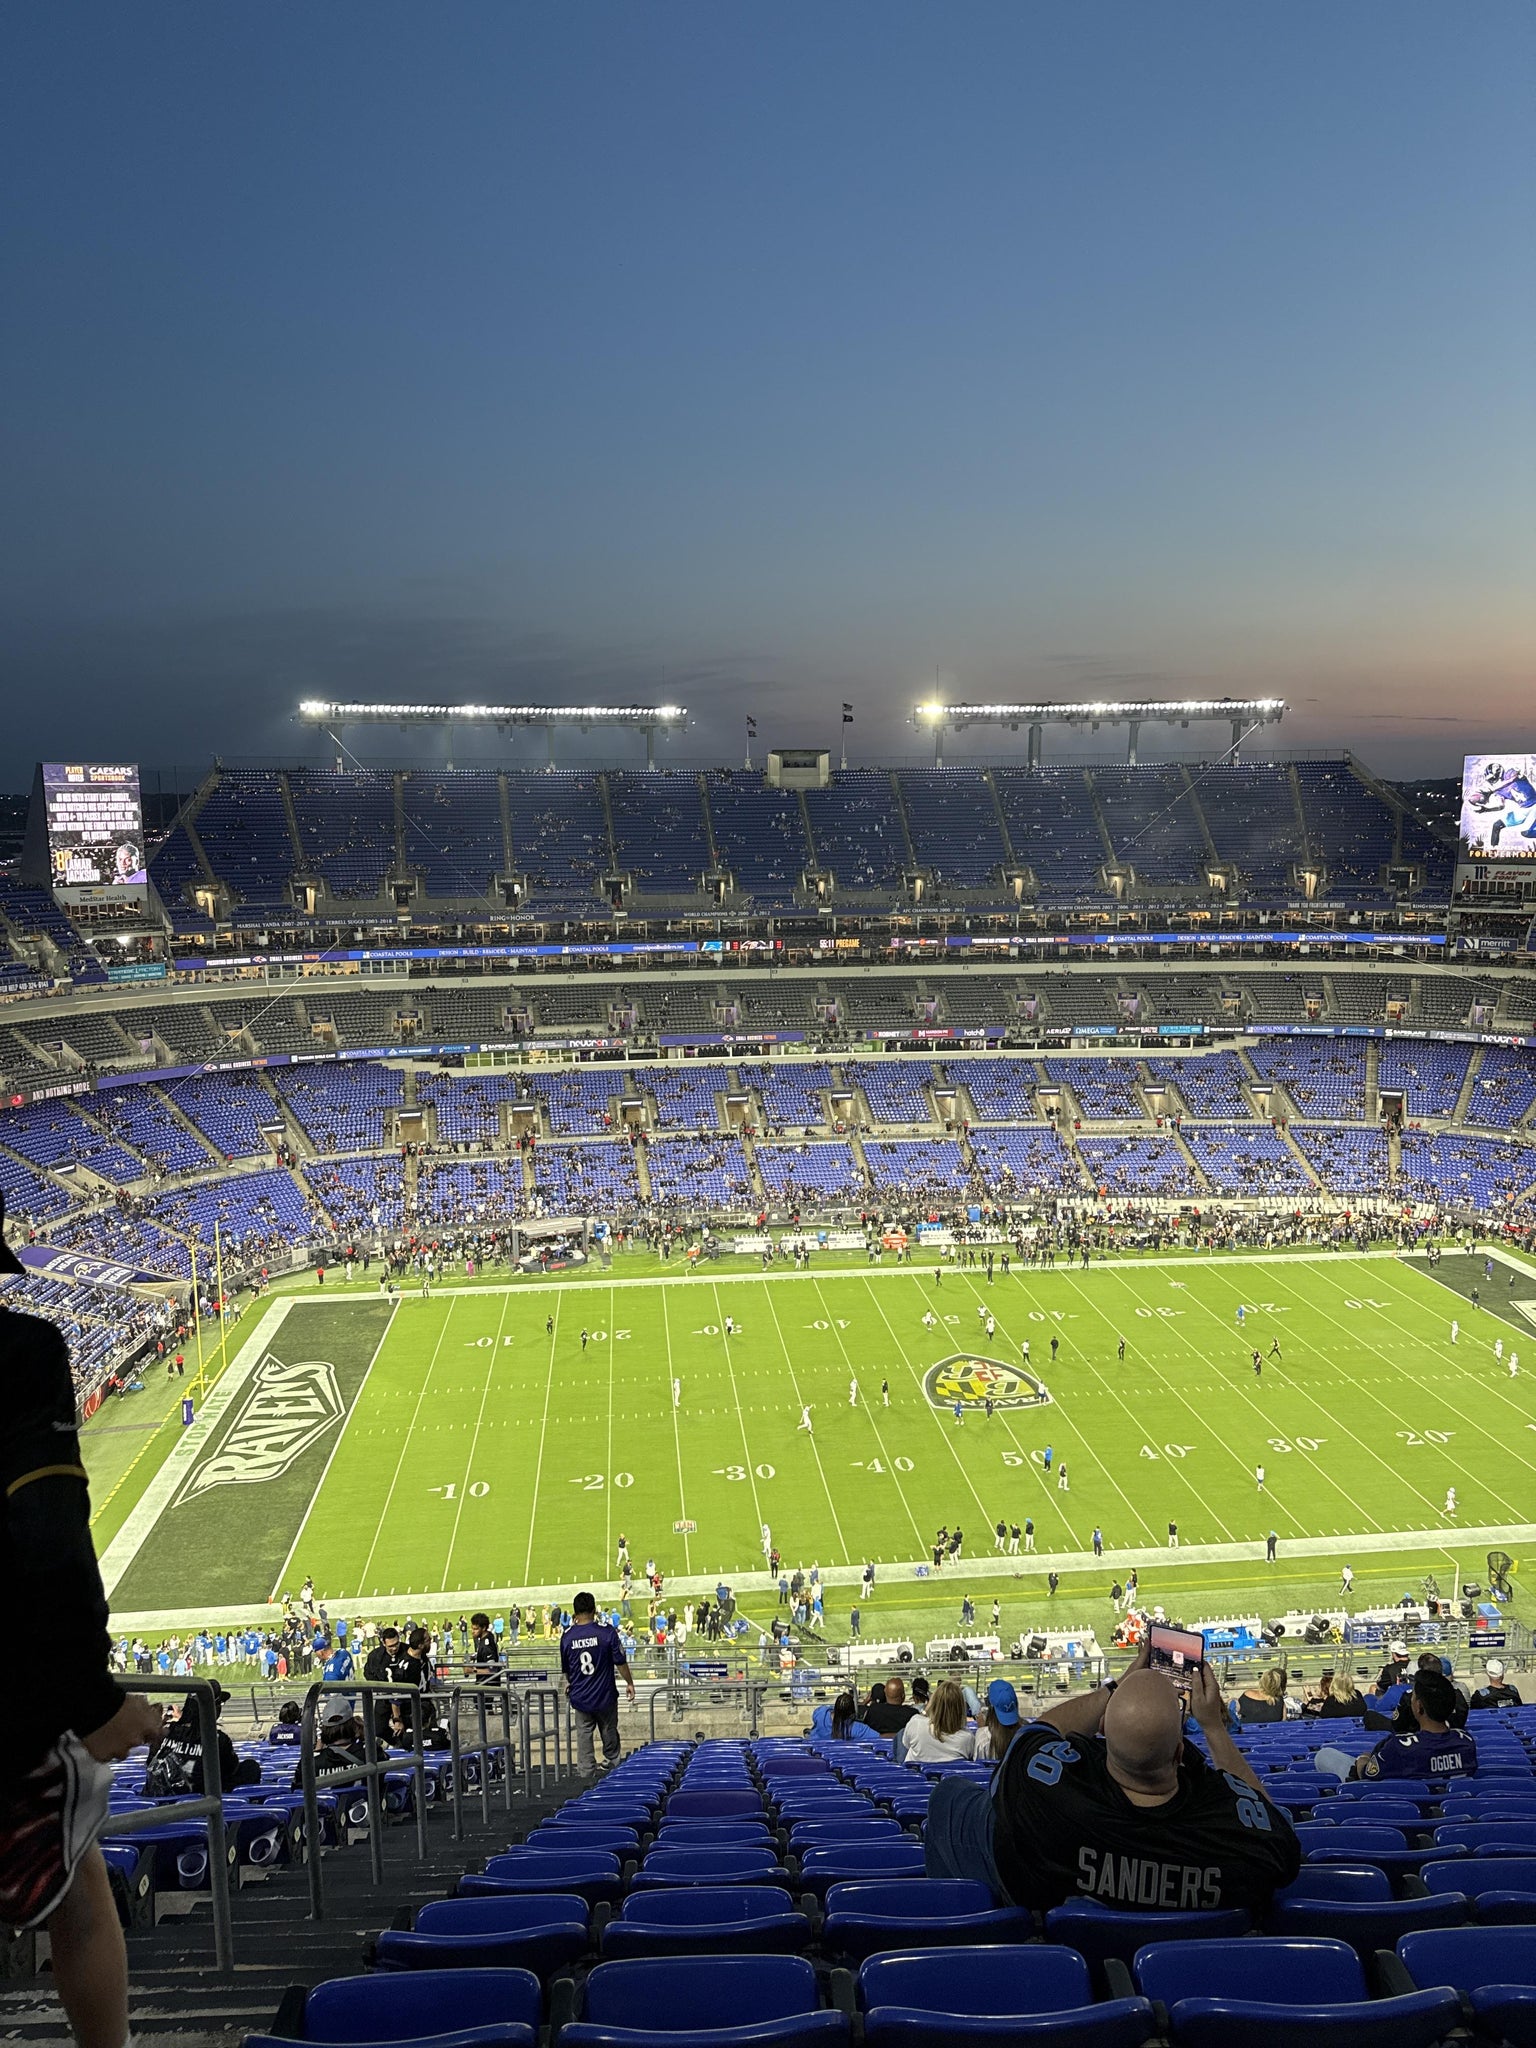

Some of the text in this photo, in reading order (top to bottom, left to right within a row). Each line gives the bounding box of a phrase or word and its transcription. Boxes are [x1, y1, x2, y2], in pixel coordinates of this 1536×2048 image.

[89, 767, 133, 775] CAESARS
[56, 851, 65, 871] 8
[66, 858, 92, 870] LAMAR
[67, 869, 100, 882] JACKSON
[820, 939, 860, 948] 55:11 PREGAME
[1480, 940, 1510, 948] merritt
[1481, 1034, 1525, 1044] neutron
[32, 1081, 90, 1100] AND NOTHING MORE
[174, 1390, 233, 1457] STOP HATE
[191, 1362, 339, 1491] RAVENS
[1267, 1437, 1319, 1453] 30
[1395, 1430, 1449, 1446] 20
[1001, 1449, 1048, 1466] 50
[1138, 1444, 1187, 1459] 40
[724, 1464, 776, 1481] 30
[864, 1457, 915, 1474] 40
[582, 1473, 634, 1490] 20
[441, 1481, 490, 1500] 10
[571, 1636, 598, 1649] JACKSON
[579, 1650, 596, 1675] 8
[1027, 1740, 1081, 1786] 20
[1430, 1752, 1462, 1773] OGDEN
[1076, 1846, 1222, 1909] SANDERS
